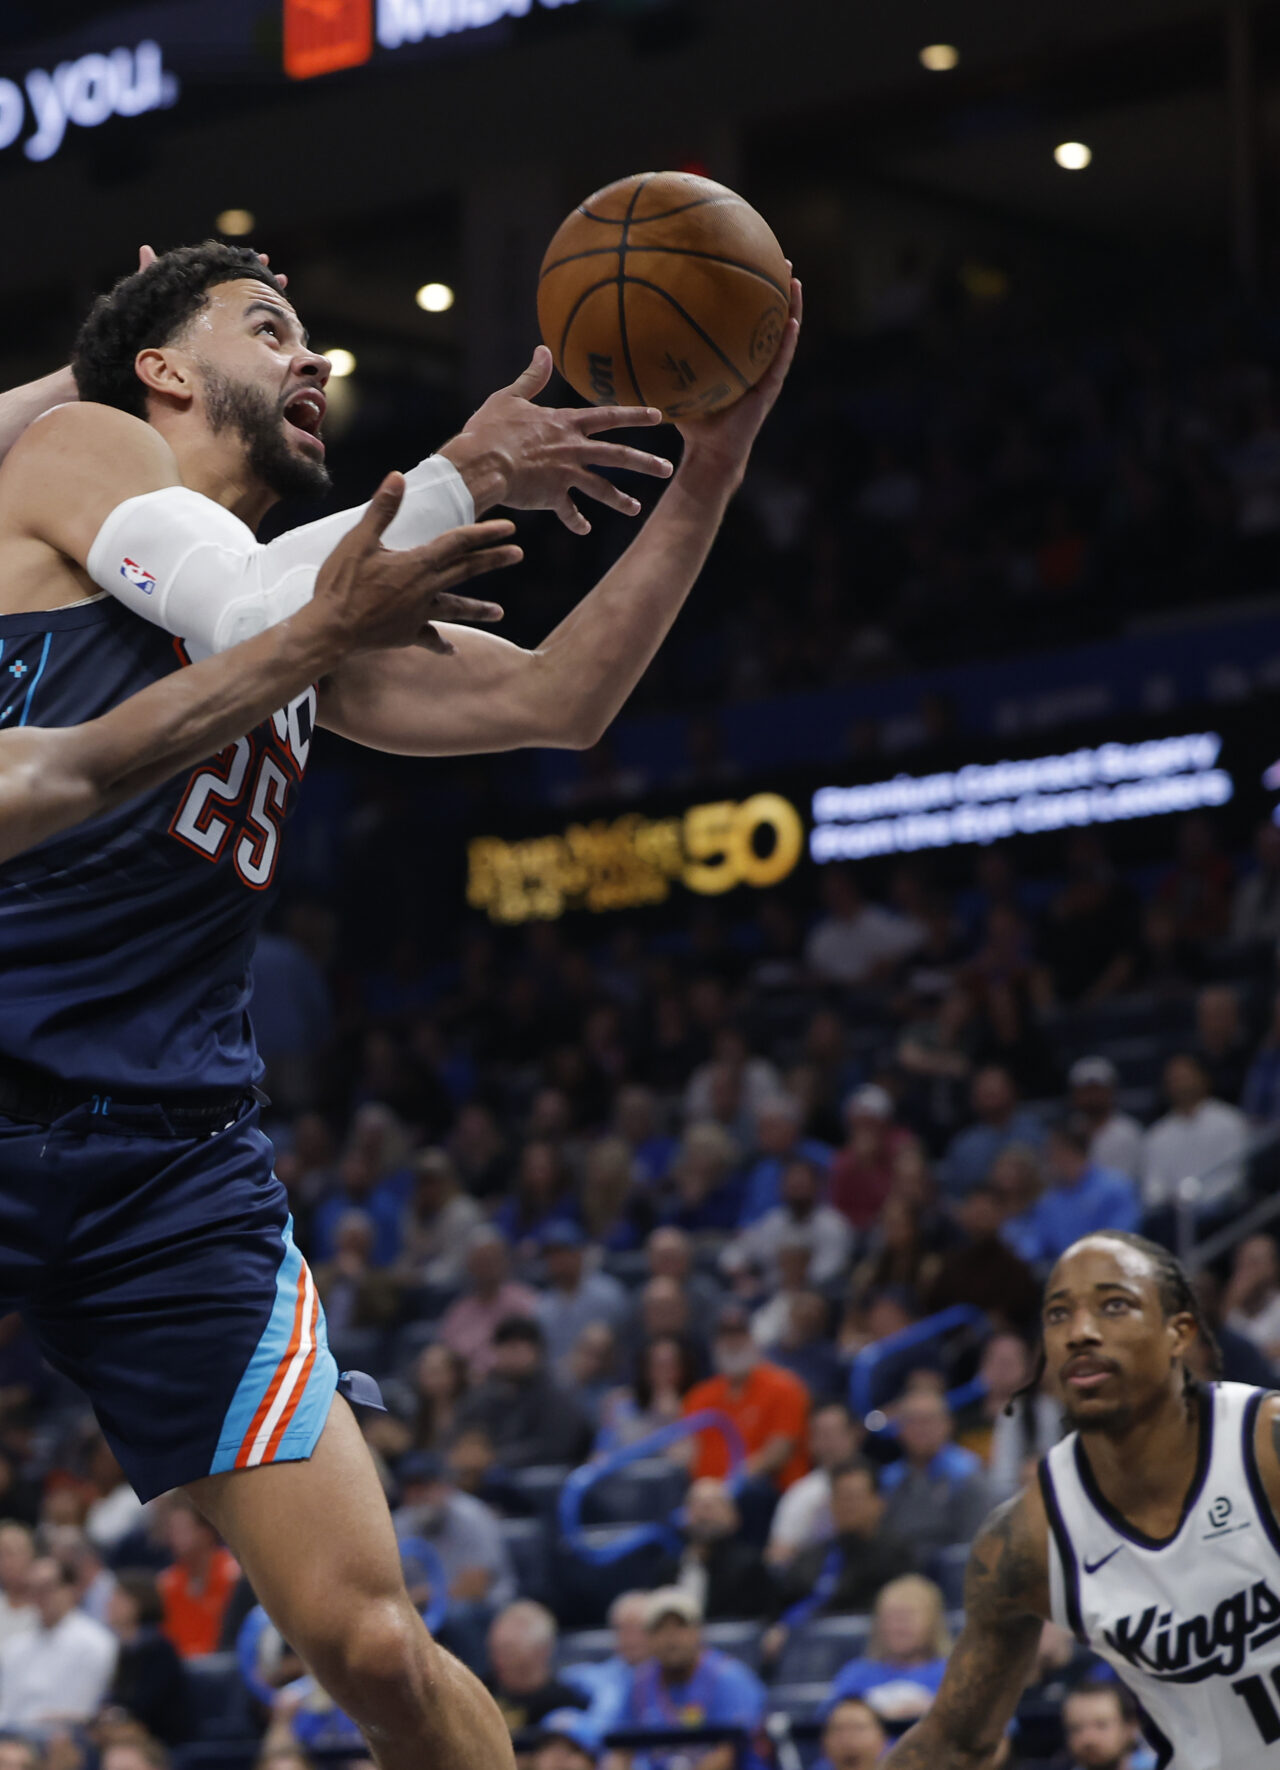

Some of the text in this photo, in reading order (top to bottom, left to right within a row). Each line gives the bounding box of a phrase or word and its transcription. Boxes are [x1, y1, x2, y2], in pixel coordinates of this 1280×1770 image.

[168, 732, 294, 890] 25
[682, 791, 803, 896] 50
[1101, 1578, 1280, 1683] Kings
[1231, 1664, 1280, 1745] 1
